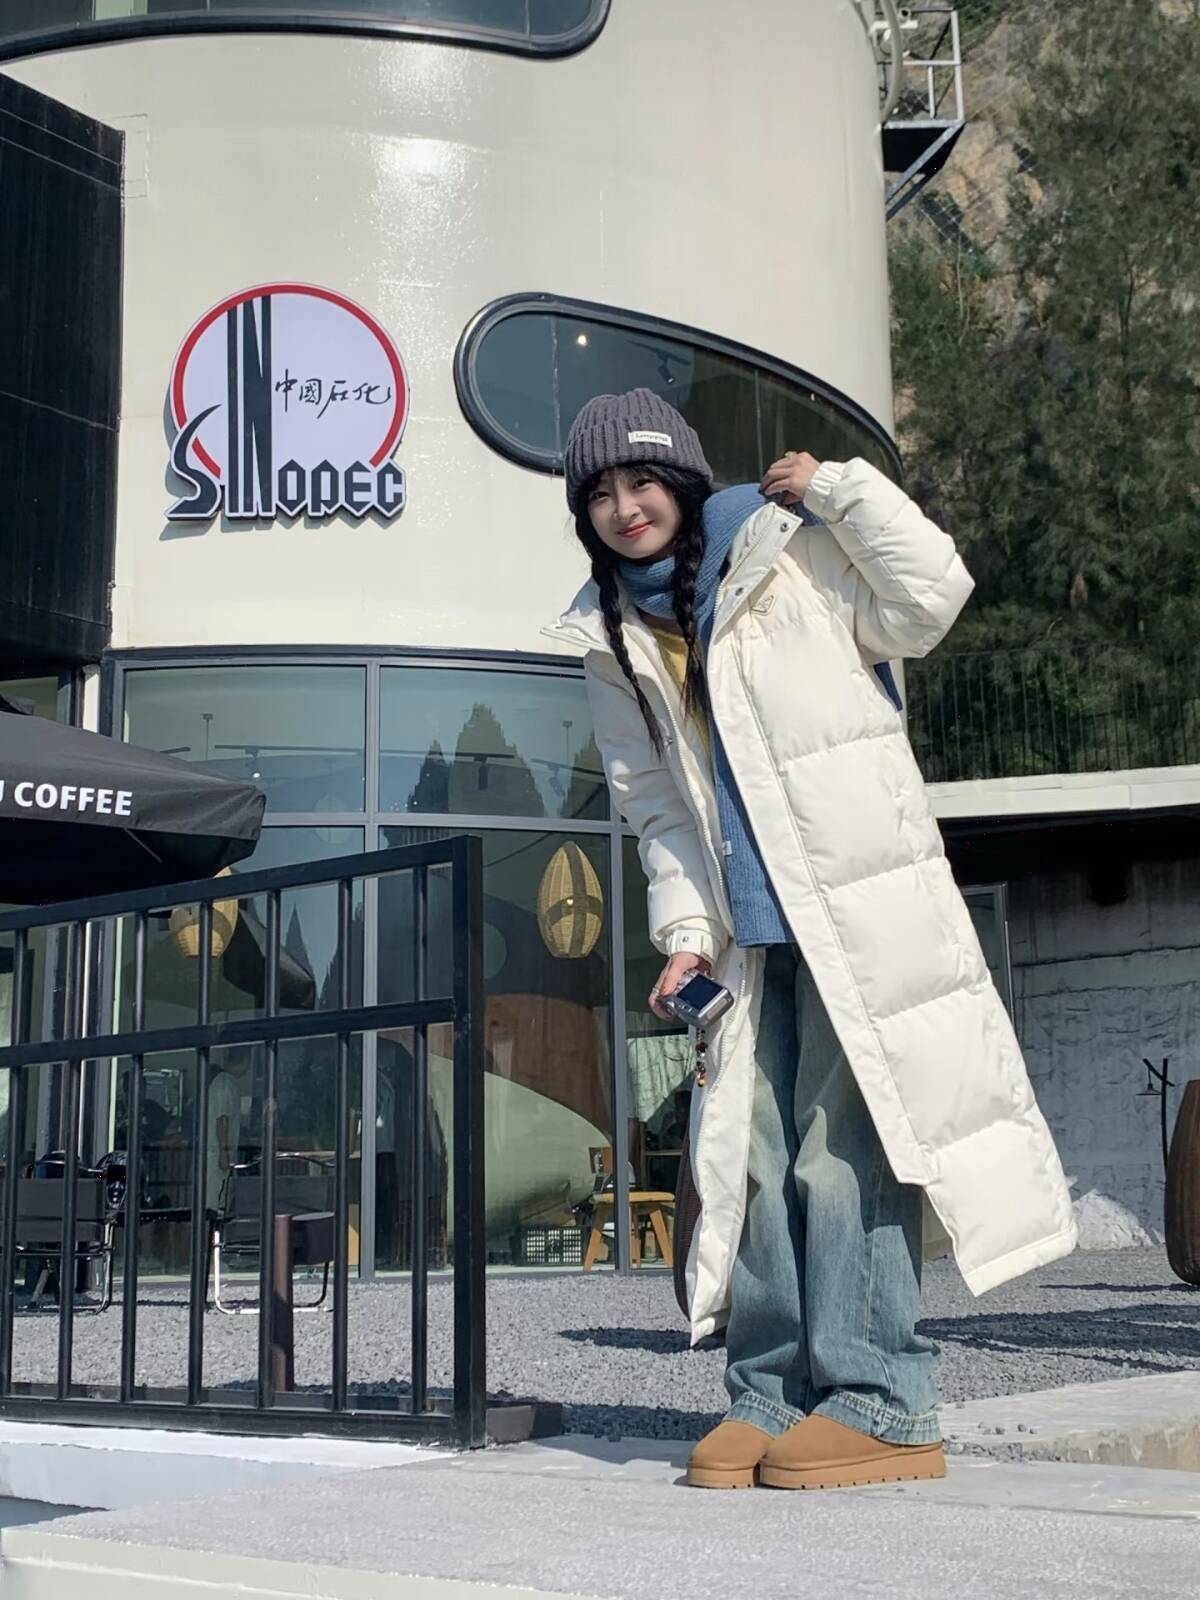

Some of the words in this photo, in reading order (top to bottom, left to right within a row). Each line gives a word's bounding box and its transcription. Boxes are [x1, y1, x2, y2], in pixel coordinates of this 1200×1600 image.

[166, 294, 403, 515] SINOPEC
[275, 368, 391, 419] 中國石化
[14, 781, 133, 816] COFFEE
